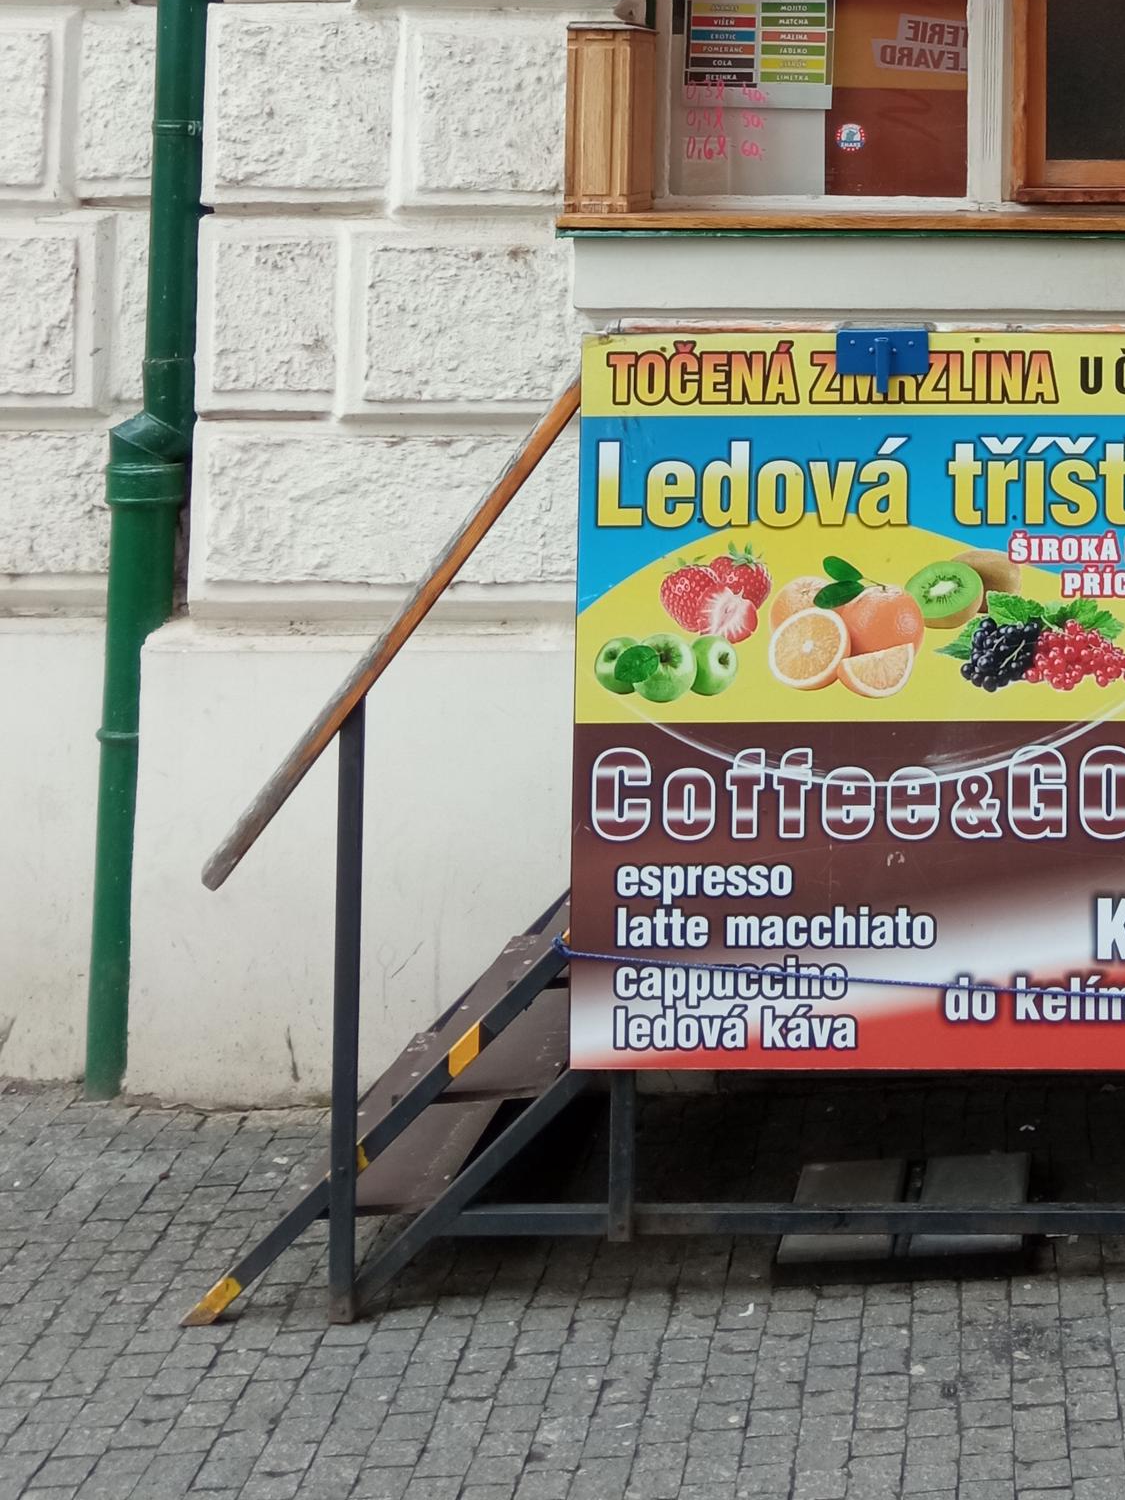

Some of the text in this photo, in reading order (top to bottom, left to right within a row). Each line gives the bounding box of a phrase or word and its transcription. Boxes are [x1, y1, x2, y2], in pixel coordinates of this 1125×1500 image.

[778, 18, 809, 26] MATCHA
[780, 32, 808, 41] MALINA
[712, 59, 733, 67] COLA
[776, 74, 809, 82] LIMETKA
[607, 342, 799, 405] TOČENÁ
[1079, 357, 1102, 395] U
[596, 436, 911, 530] Ledová
[1008, 530, 1119, 564] ŠIROKÁ
[615, 863, 793, 905] espresso
[615, 907, 937, 950] latte macchiato
[614, 959, 850, 1011] cappuccino
[943, 977, 998, 1024] do
[614, 1008, 858, 1052] ledová káva
